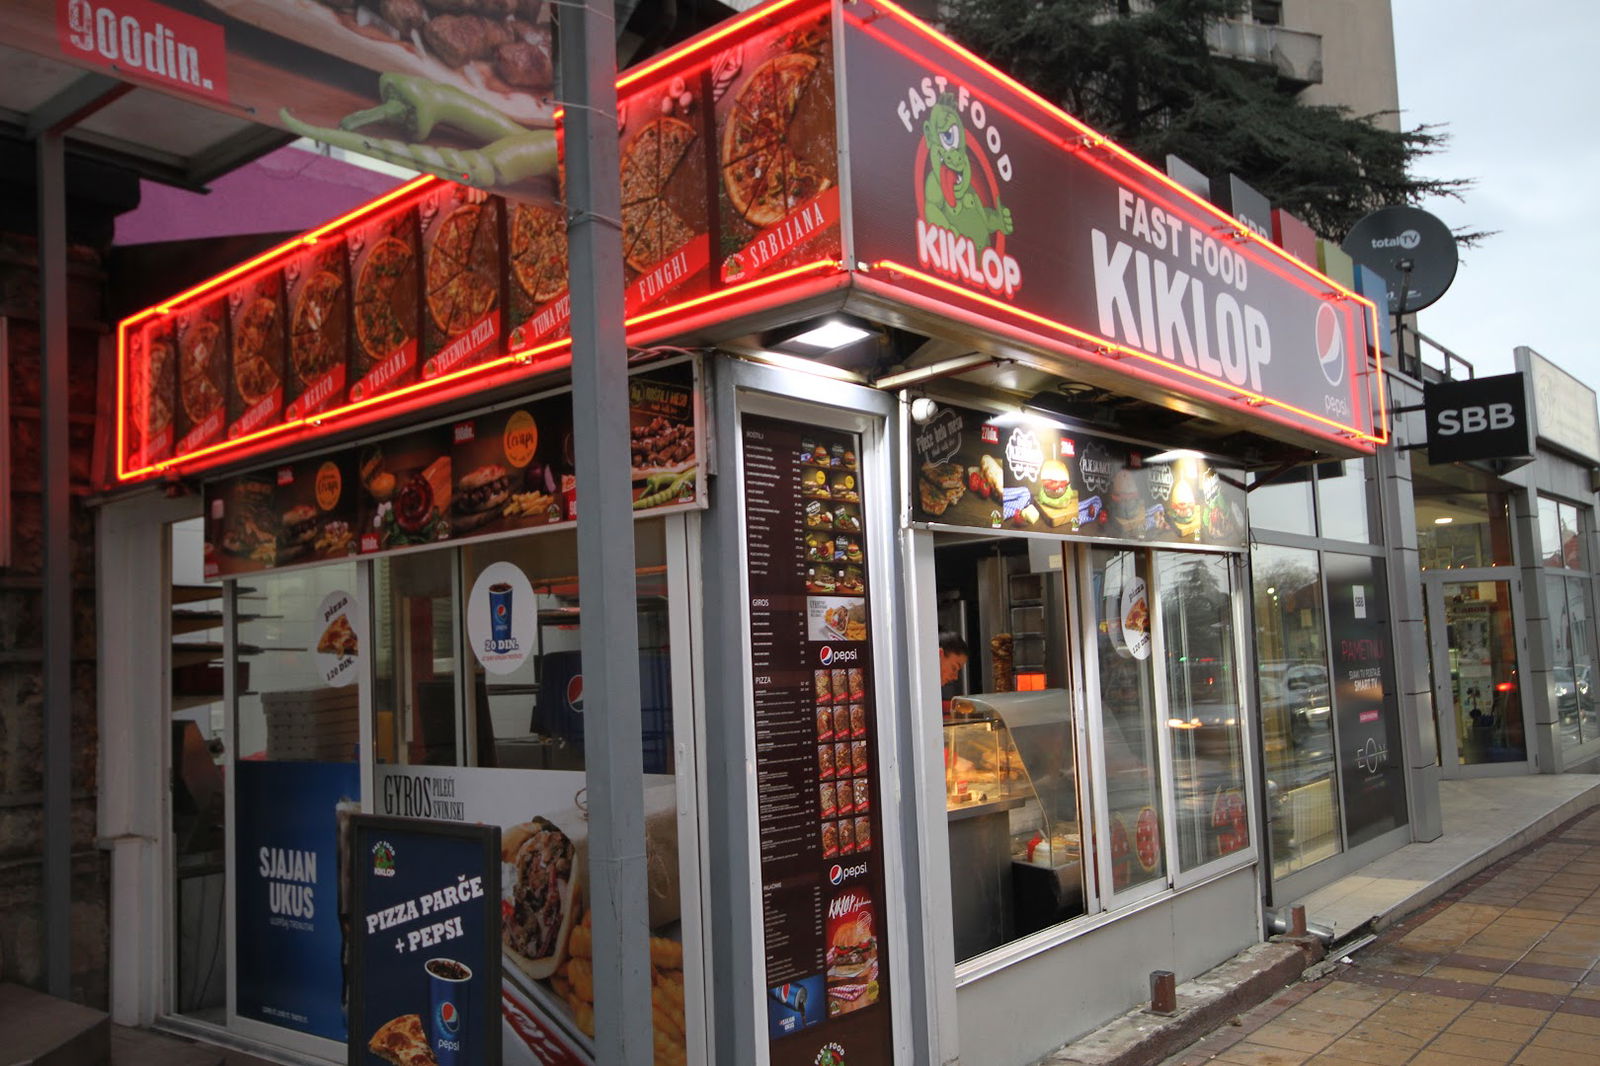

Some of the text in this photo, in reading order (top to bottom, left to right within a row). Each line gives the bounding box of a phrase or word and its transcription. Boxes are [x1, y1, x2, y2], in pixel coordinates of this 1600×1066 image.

[897, 76, 1013, 182] FAST FOOD
[749, 201, 825, 268] SRBIJANA
[1118, 186, 1248, 292] FAST FOOD
[916, 219, 1022, 295] KIKLOP
[638, 251, 689, 303] FUNGHI
[532, 307, 557, 339] TUNA
[1091, 228, 1272, 393] KIKLOP
[471, 316, 495, 349] PIZZA
[368, 350, 407, 392] TOSCANA
[304, 375, 333, 410] MEXICO
[1437, 401, 1516, 437] SBB
[324, 597, 348, 622] pizza
[1128, 584, 1145, 603] pizza
[833, 648, 858, 663] pepsi
[755, 676, 772, 684] PIZZA
[384, 775, 432, 818] GYROS
[433, 801, 465, 821] SVINJSKI
[259, 846, 317, 884] SJAJAN
[843, 861, 868, 880] pepsi
[269, 881, 314, 919] UKUS
[366, 874, 484, 934] PIZZA PARČE
[395, 916, 464, 954] + PEPSI
[438, 1038, 460, 1052] pepsi
